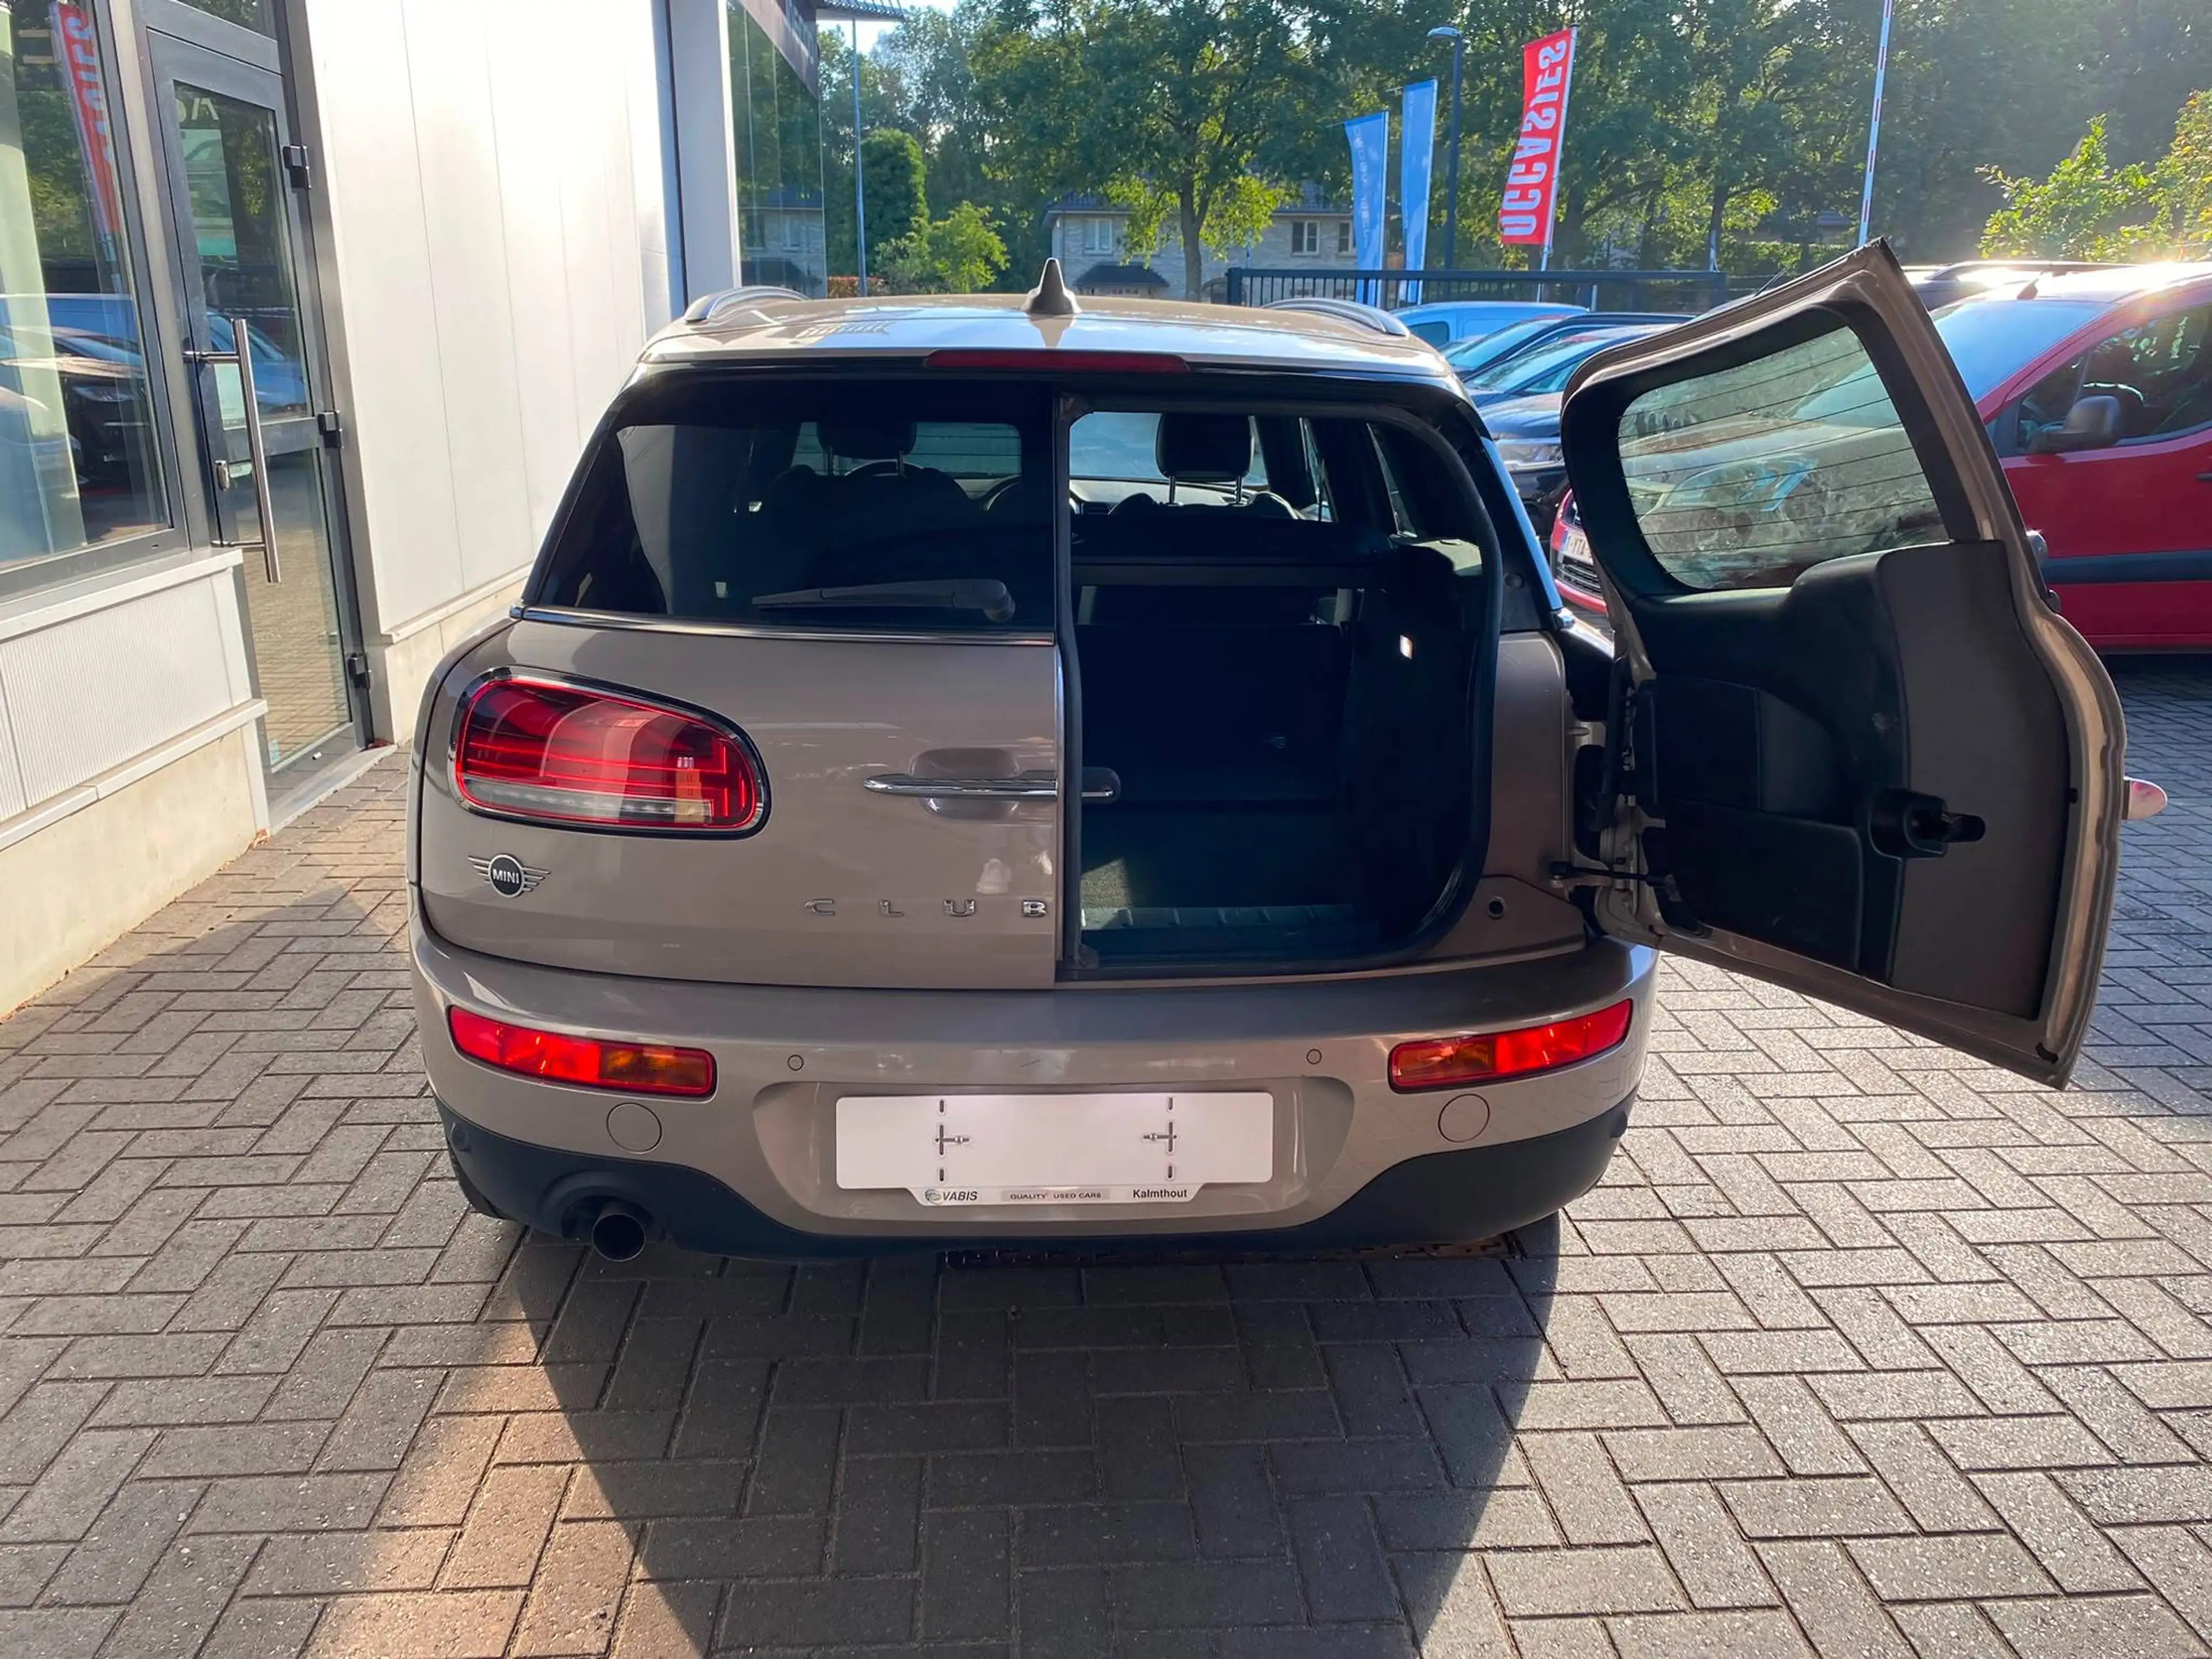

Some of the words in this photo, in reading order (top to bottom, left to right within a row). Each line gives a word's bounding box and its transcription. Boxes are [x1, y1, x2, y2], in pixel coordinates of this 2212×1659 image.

[492, 868, 520, 884] MINI
[805, 898, 1047, 917] CLUB
[943, 1191, 978, 1201] VABIS
[1132, 1188, 1187, 1199] Kalmthout
